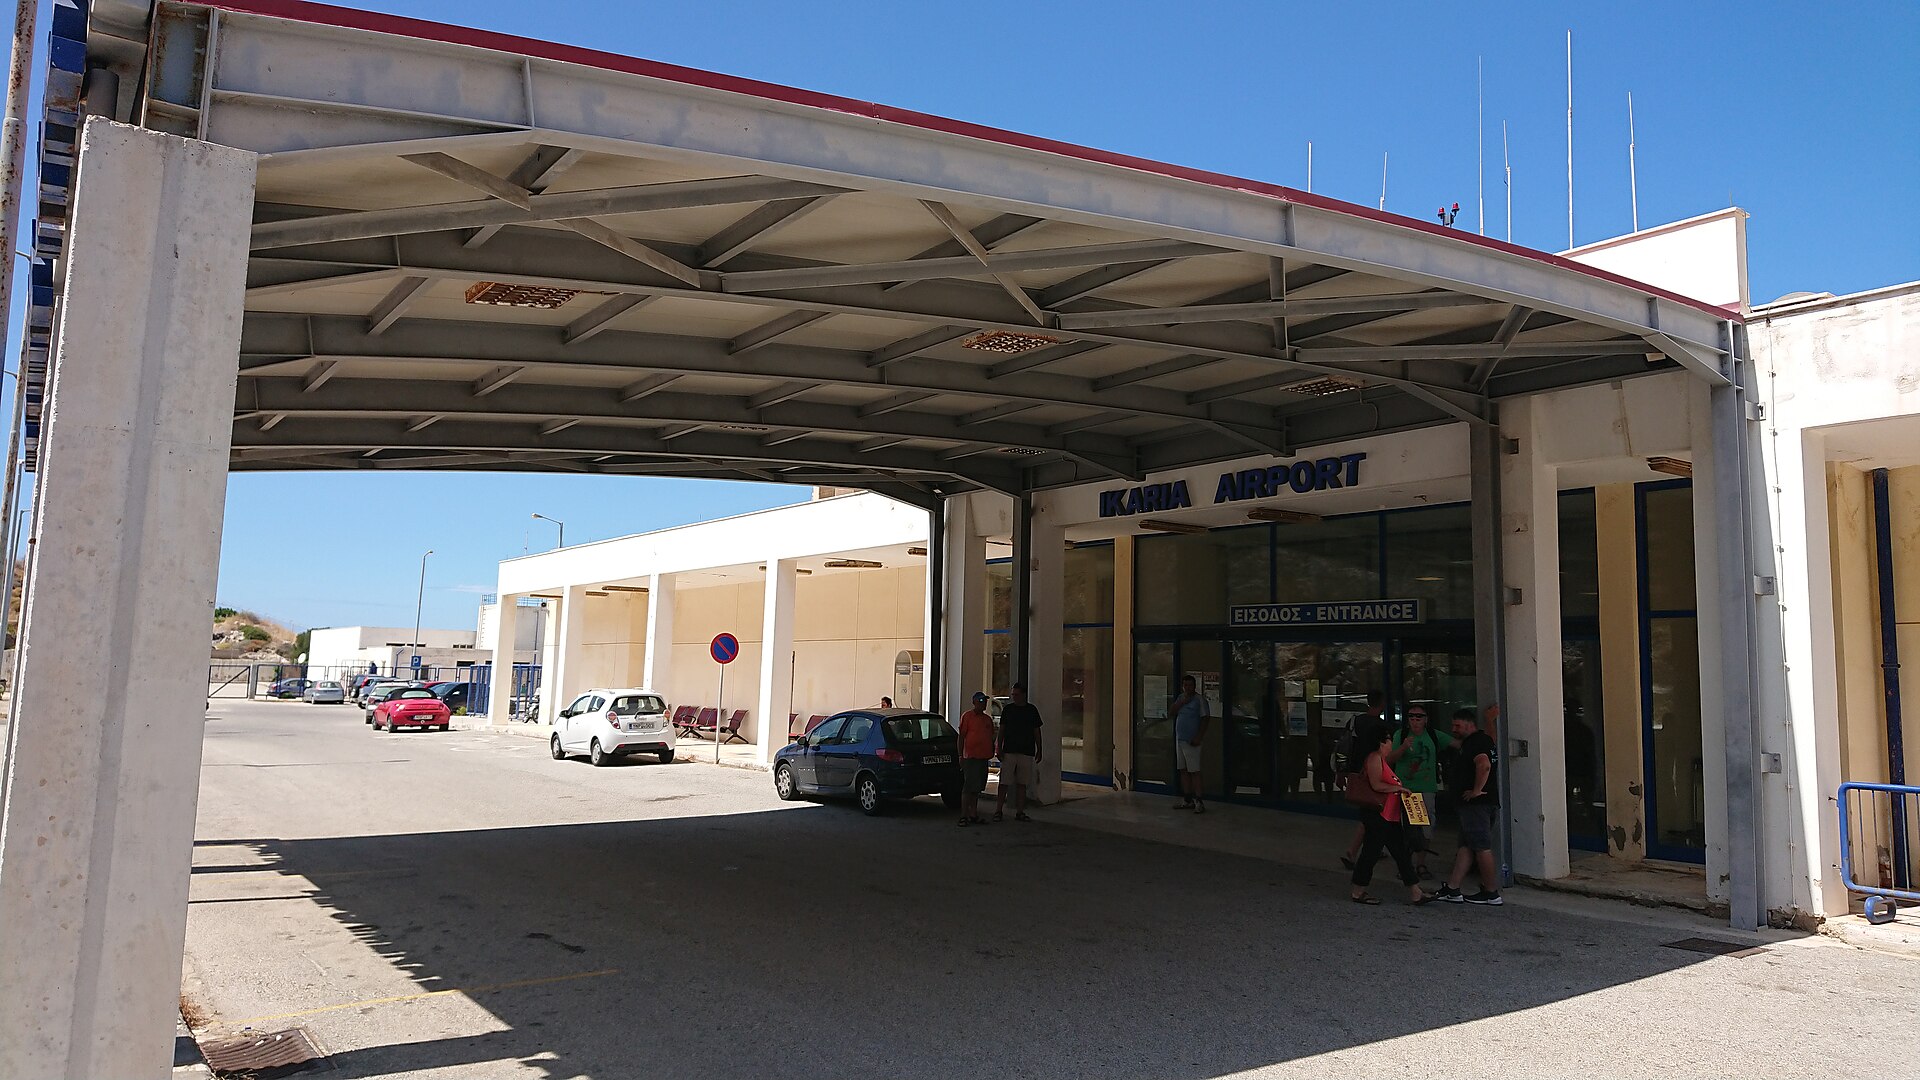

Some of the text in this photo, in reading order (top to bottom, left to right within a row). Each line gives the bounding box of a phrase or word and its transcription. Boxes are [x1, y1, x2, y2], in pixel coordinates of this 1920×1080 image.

[1100, 452, 1367, 517] IKARIA AIRPORT
[1234, 603, 1413, 623] ΕΙΣΟΔΟΣ ENTRANCE
[413, 657, 419, 666] P
